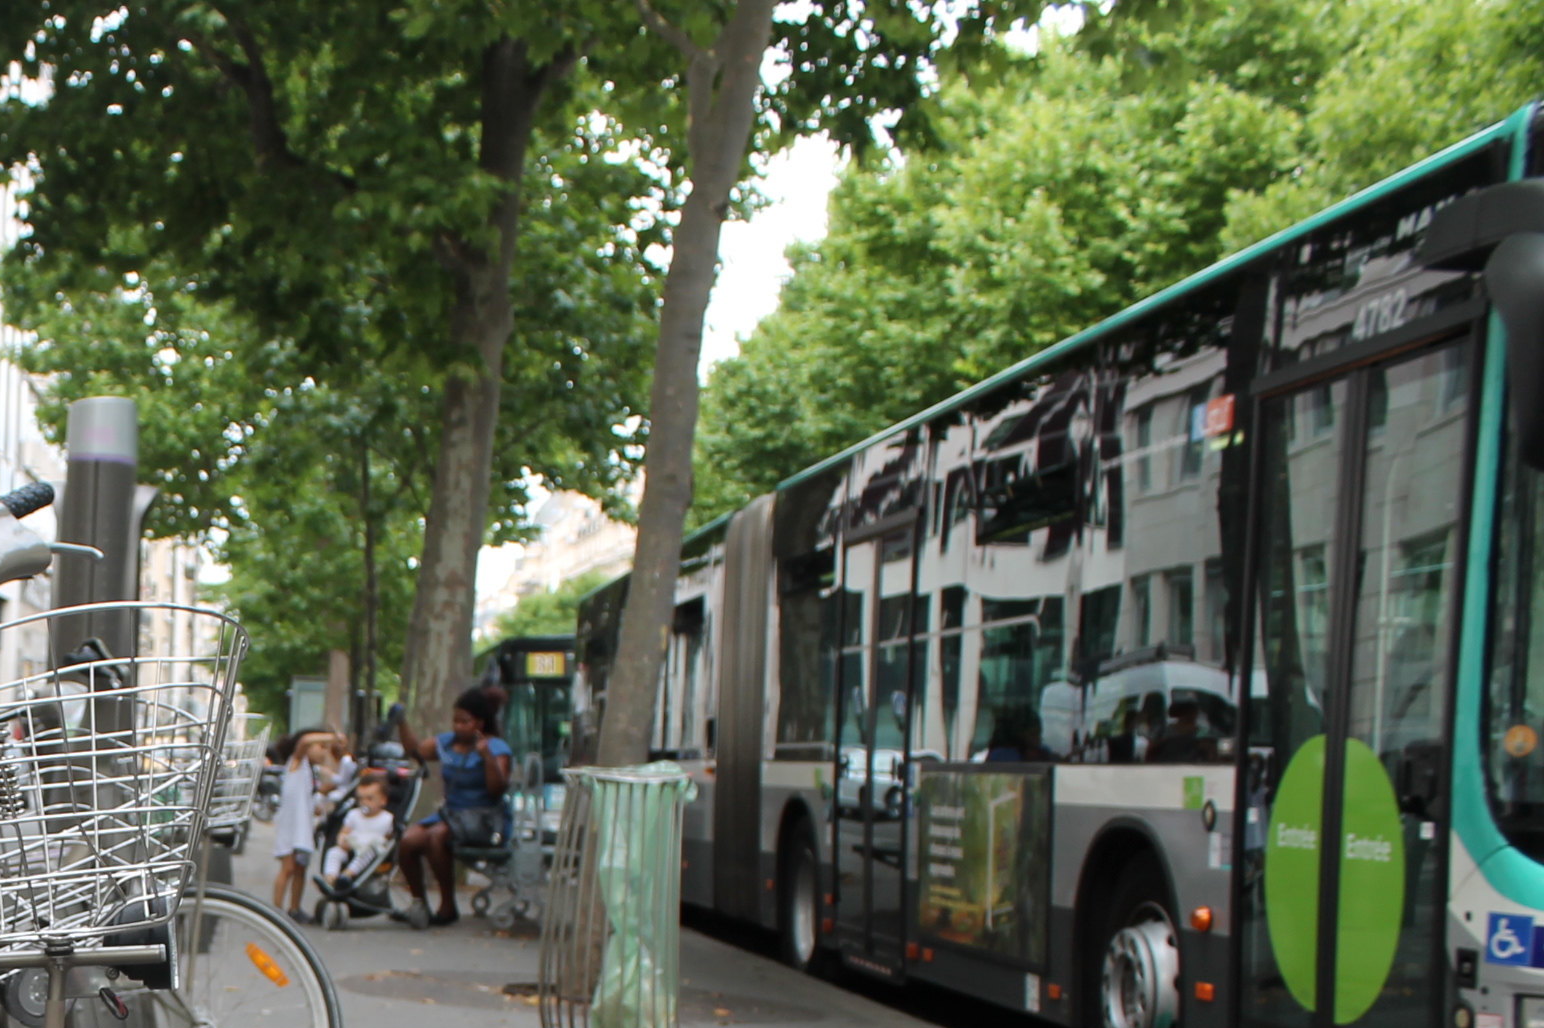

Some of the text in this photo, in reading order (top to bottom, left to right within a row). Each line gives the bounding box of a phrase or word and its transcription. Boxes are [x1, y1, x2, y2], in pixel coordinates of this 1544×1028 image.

[1352, 287, 1406, 341] 4782
[1278, 823, 1317, 849] Entrée
[1345, 833, 1391, 862] Entrée
